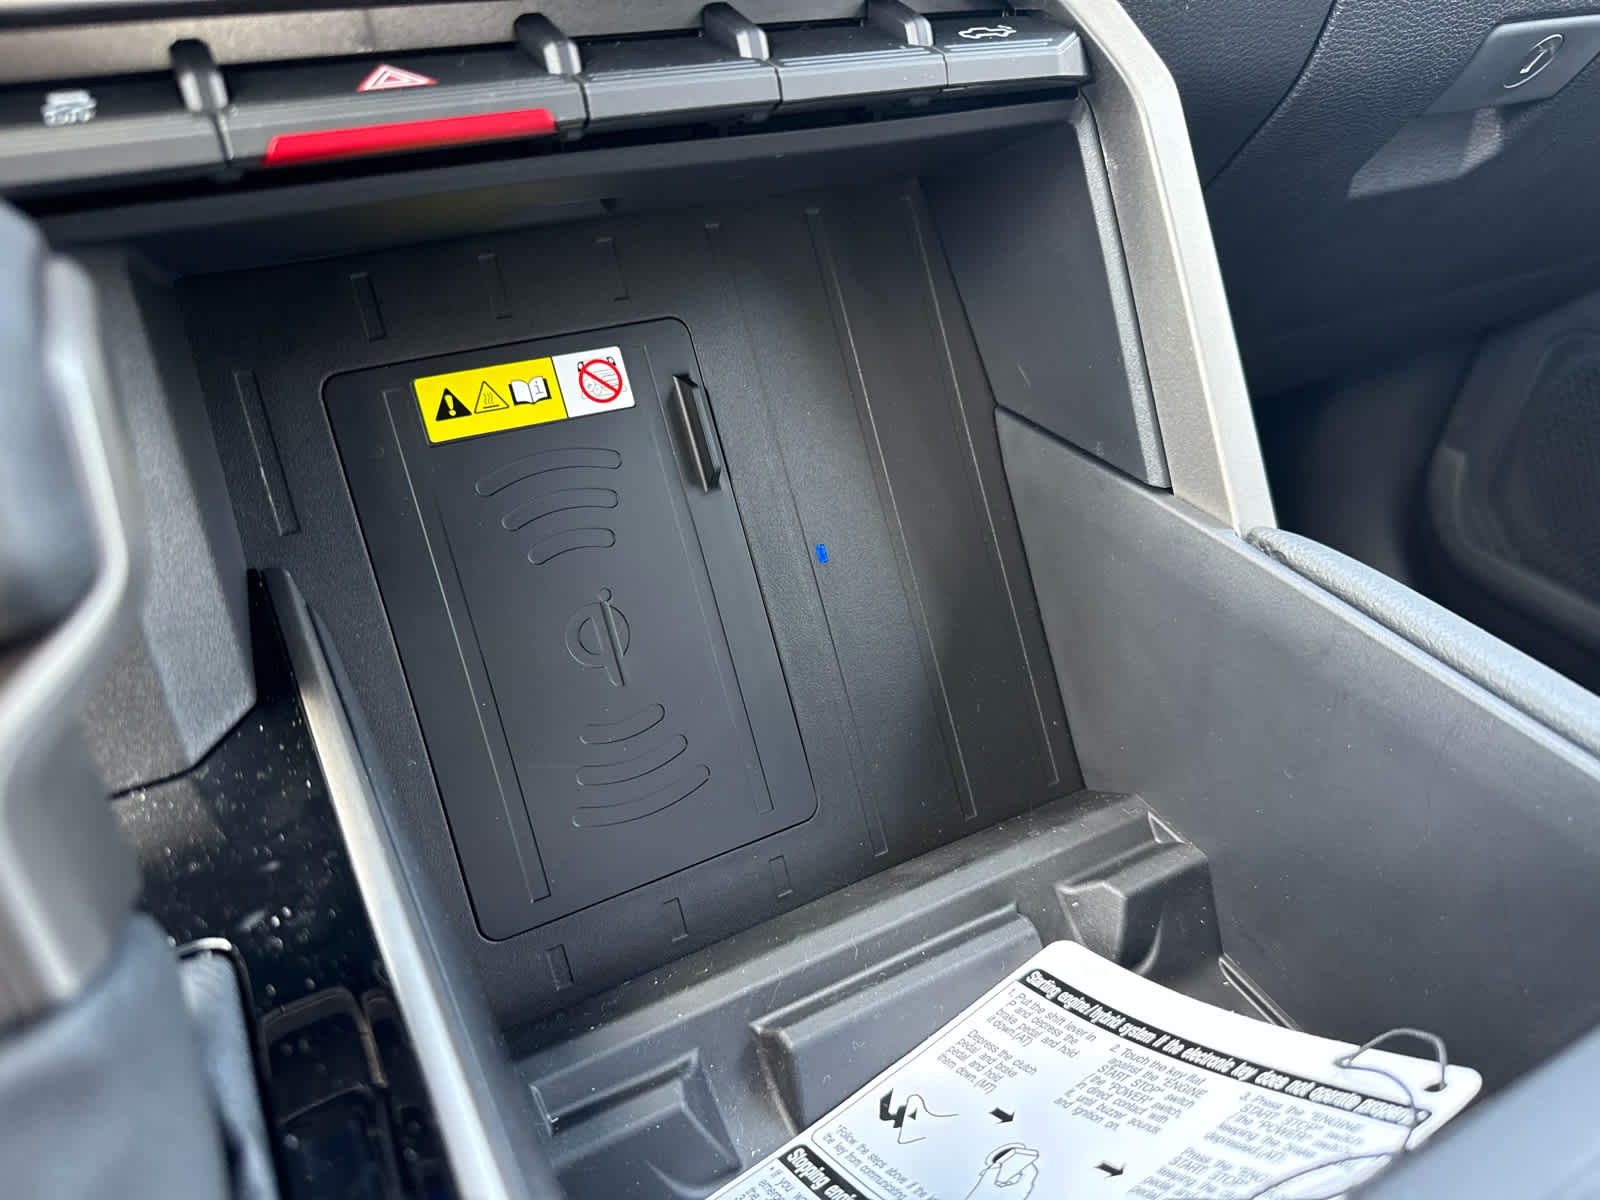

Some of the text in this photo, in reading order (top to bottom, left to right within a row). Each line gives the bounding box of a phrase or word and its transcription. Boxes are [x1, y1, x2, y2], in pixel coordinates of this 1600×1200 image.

[996, 1008, 1080, 1058] brake pedal and hold
[1014, 1007, 1033, 1019] and
[1031, 1016, 1063, 1037] depress
[1063, 1034, 1079, 1045] the
[1015, 993, 1032, 1006] Put
[1030, 1001, 1046, 1014] the
[1045, 1012, 1067, 1025] shift
[1064, 1021, 1088, 1036] lever
[1085, 1032, 1097, 1042] in
[1026, 971, 1061, 1000] Starting
[1119, 1022, 1157, 1044] system
[1162, 1038, 1184, 1054] the
[1180, 1046, 1236, 1073] electronic
[1230, 1061, 1259, 1080] key
[1254, 1069, 1290, 1090] does
[1284, 1078, 1316, 1098] not
[968, 1029, 1037, 1075] Depress the clutch
[968, 1060, 987, 1072] and
[979, 1053, 998, 1065] and
[995, 1061, 1018, 1078] brake
[1108, 1058, 1143, 1074] against
[1142, 1070, 1159, 1081] the
[1120, 1048, 1150, 1065] Touch
[1149, 1059, 1167, 1072] the
[1166, 1067, 1187, 1079] key
[1186, 1073, 1206, 1085] flat
[1097, 1065, 1131, 1082] START
[786, 1147, 831, 1190] Stopping
